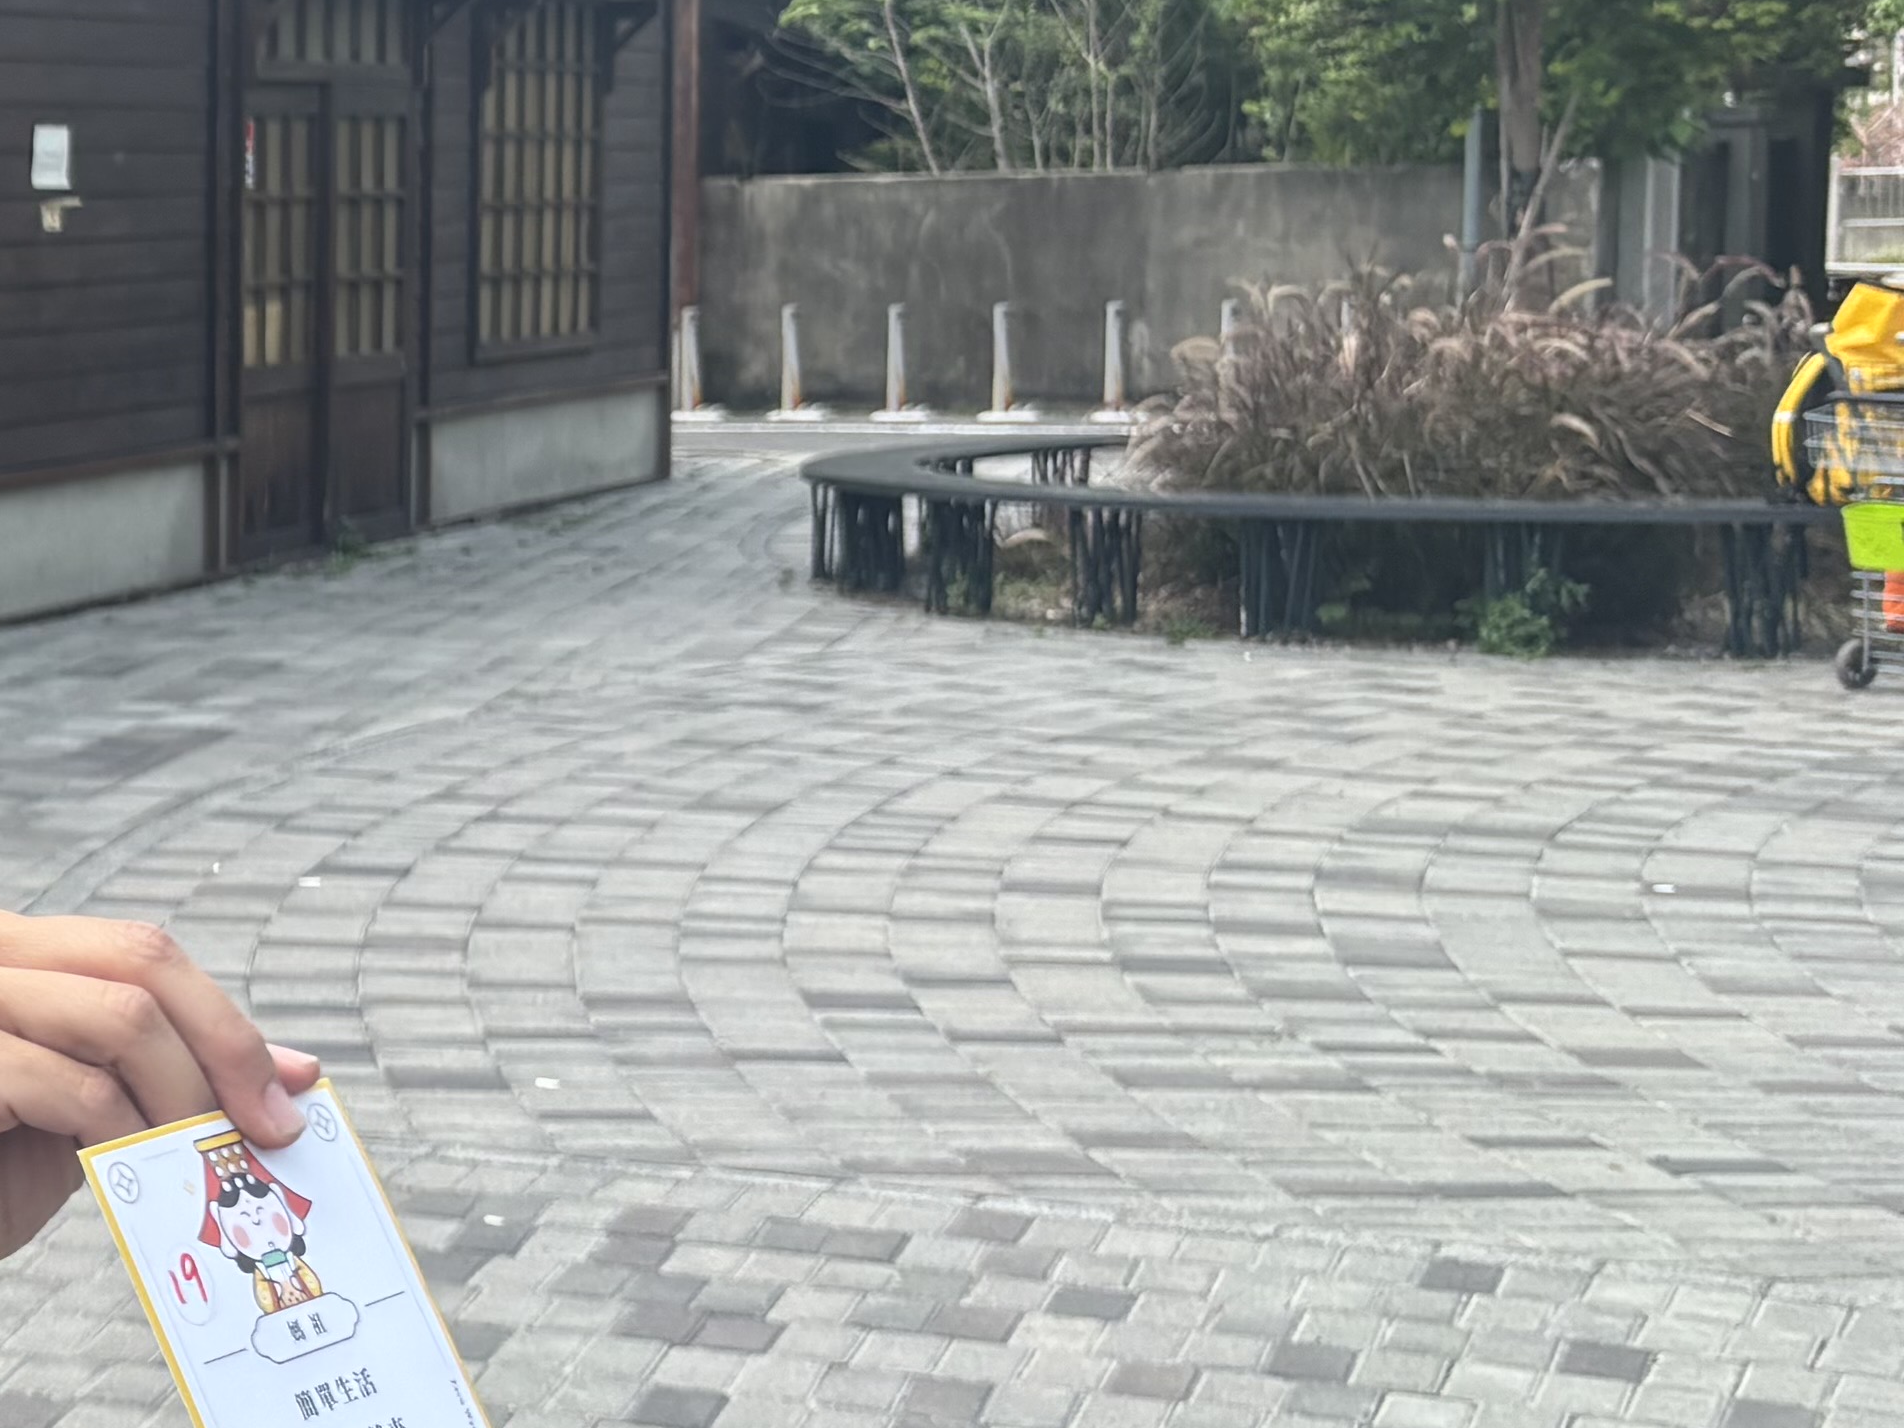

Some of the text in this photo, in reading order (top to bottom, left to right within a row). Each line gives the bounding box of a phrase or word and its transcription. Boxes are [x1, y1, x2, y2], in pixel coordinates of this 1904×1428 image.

[168, 1253, 207, 1304] 19
[295, 1368, 377, 1420] 簡單生活
